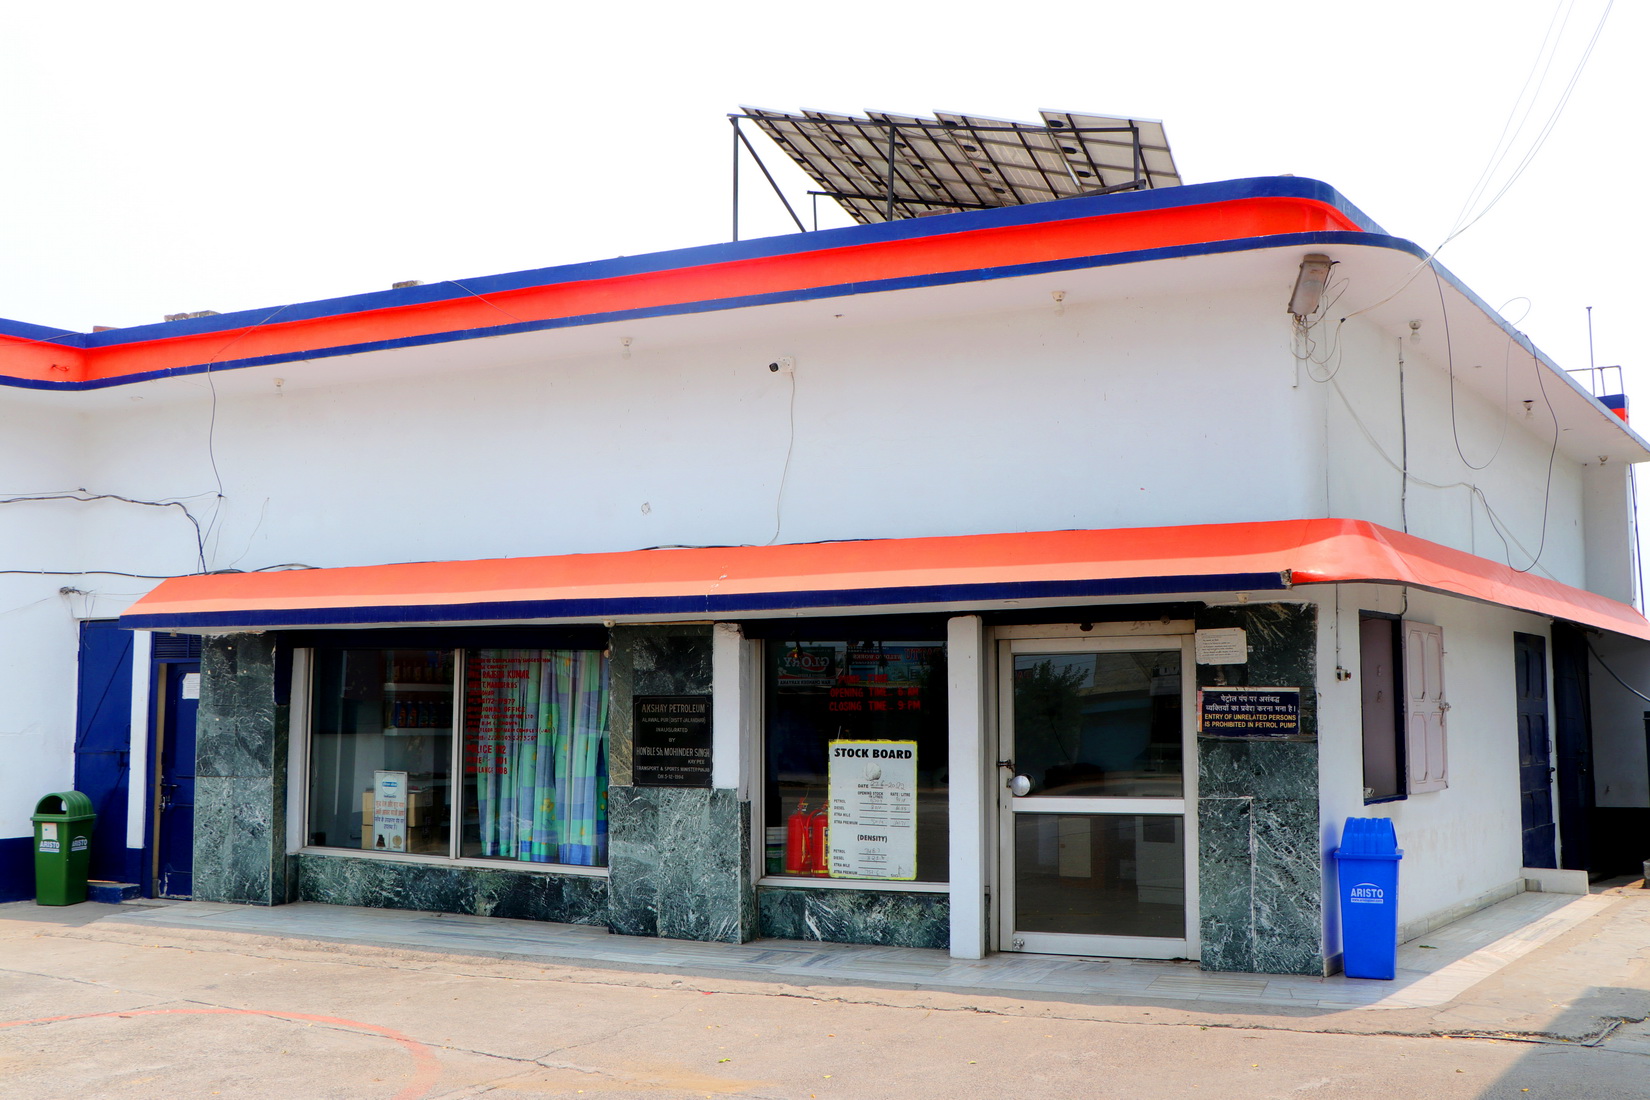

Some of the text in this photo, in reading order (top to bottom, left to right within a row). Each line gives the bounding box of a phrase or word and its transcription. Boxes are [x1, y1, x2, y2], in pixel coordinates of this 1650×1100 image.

[507, 670, 530, 679] KUMAR
[829, 687, 864, 698] OPENING
[1220, 694, 1237, 703] पेट्रोल
[641, 704, 706, 713] AKSHAY PETROLEUM
[829, 701, 862, 711] CLOSING
[664, 747, 694, 757] MOHINDER
[694, 748, 710, 758] SINGH
[834, 747, 912, 759] STOCK BOARD
[71, 838, 88, 847] ARISTO
[857, 834, 888, 843] (DENSITY)
[40, 840, 60, 849] ARISTO
[1351, 888, 1384, 898] ARISTO
